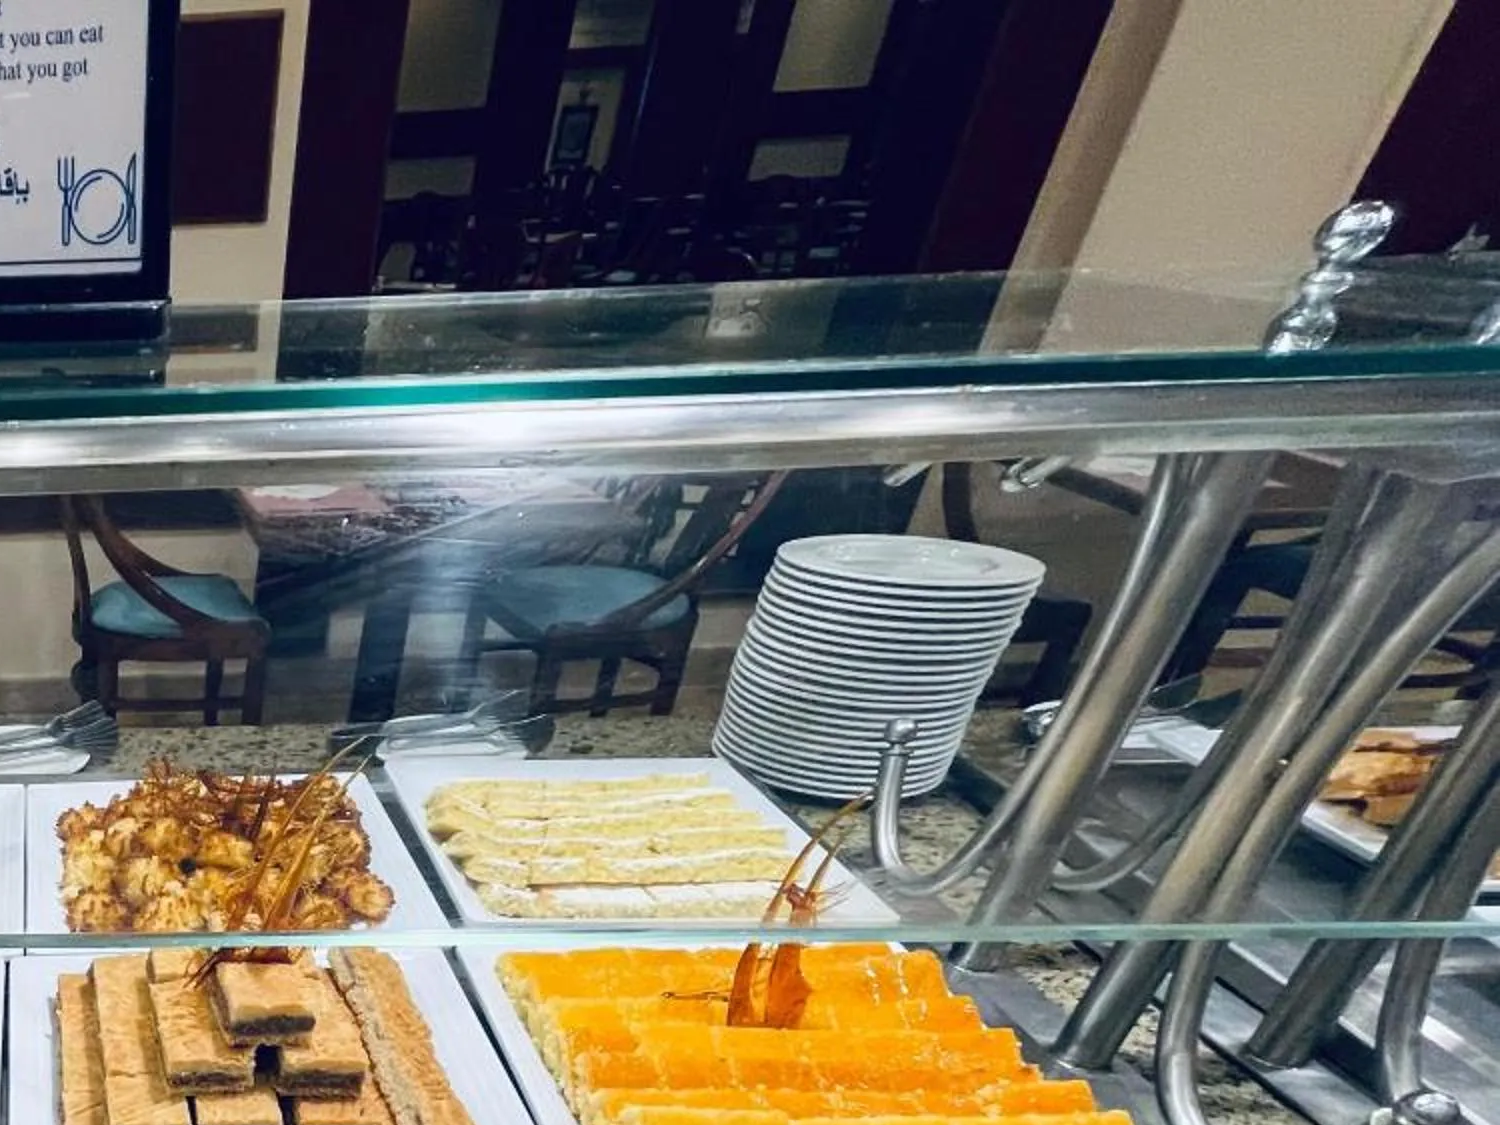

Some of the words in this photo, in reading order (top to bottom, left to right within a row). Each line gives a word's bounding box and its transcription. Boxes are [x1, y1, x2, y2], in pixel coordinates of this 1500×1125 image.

[9, 32, 41, 54] you
[45, 28, 74, 46] can
[79, 25, 104, 44] eat
[27, 62, 57, 84] you
[62, 57, 88, 82] got
